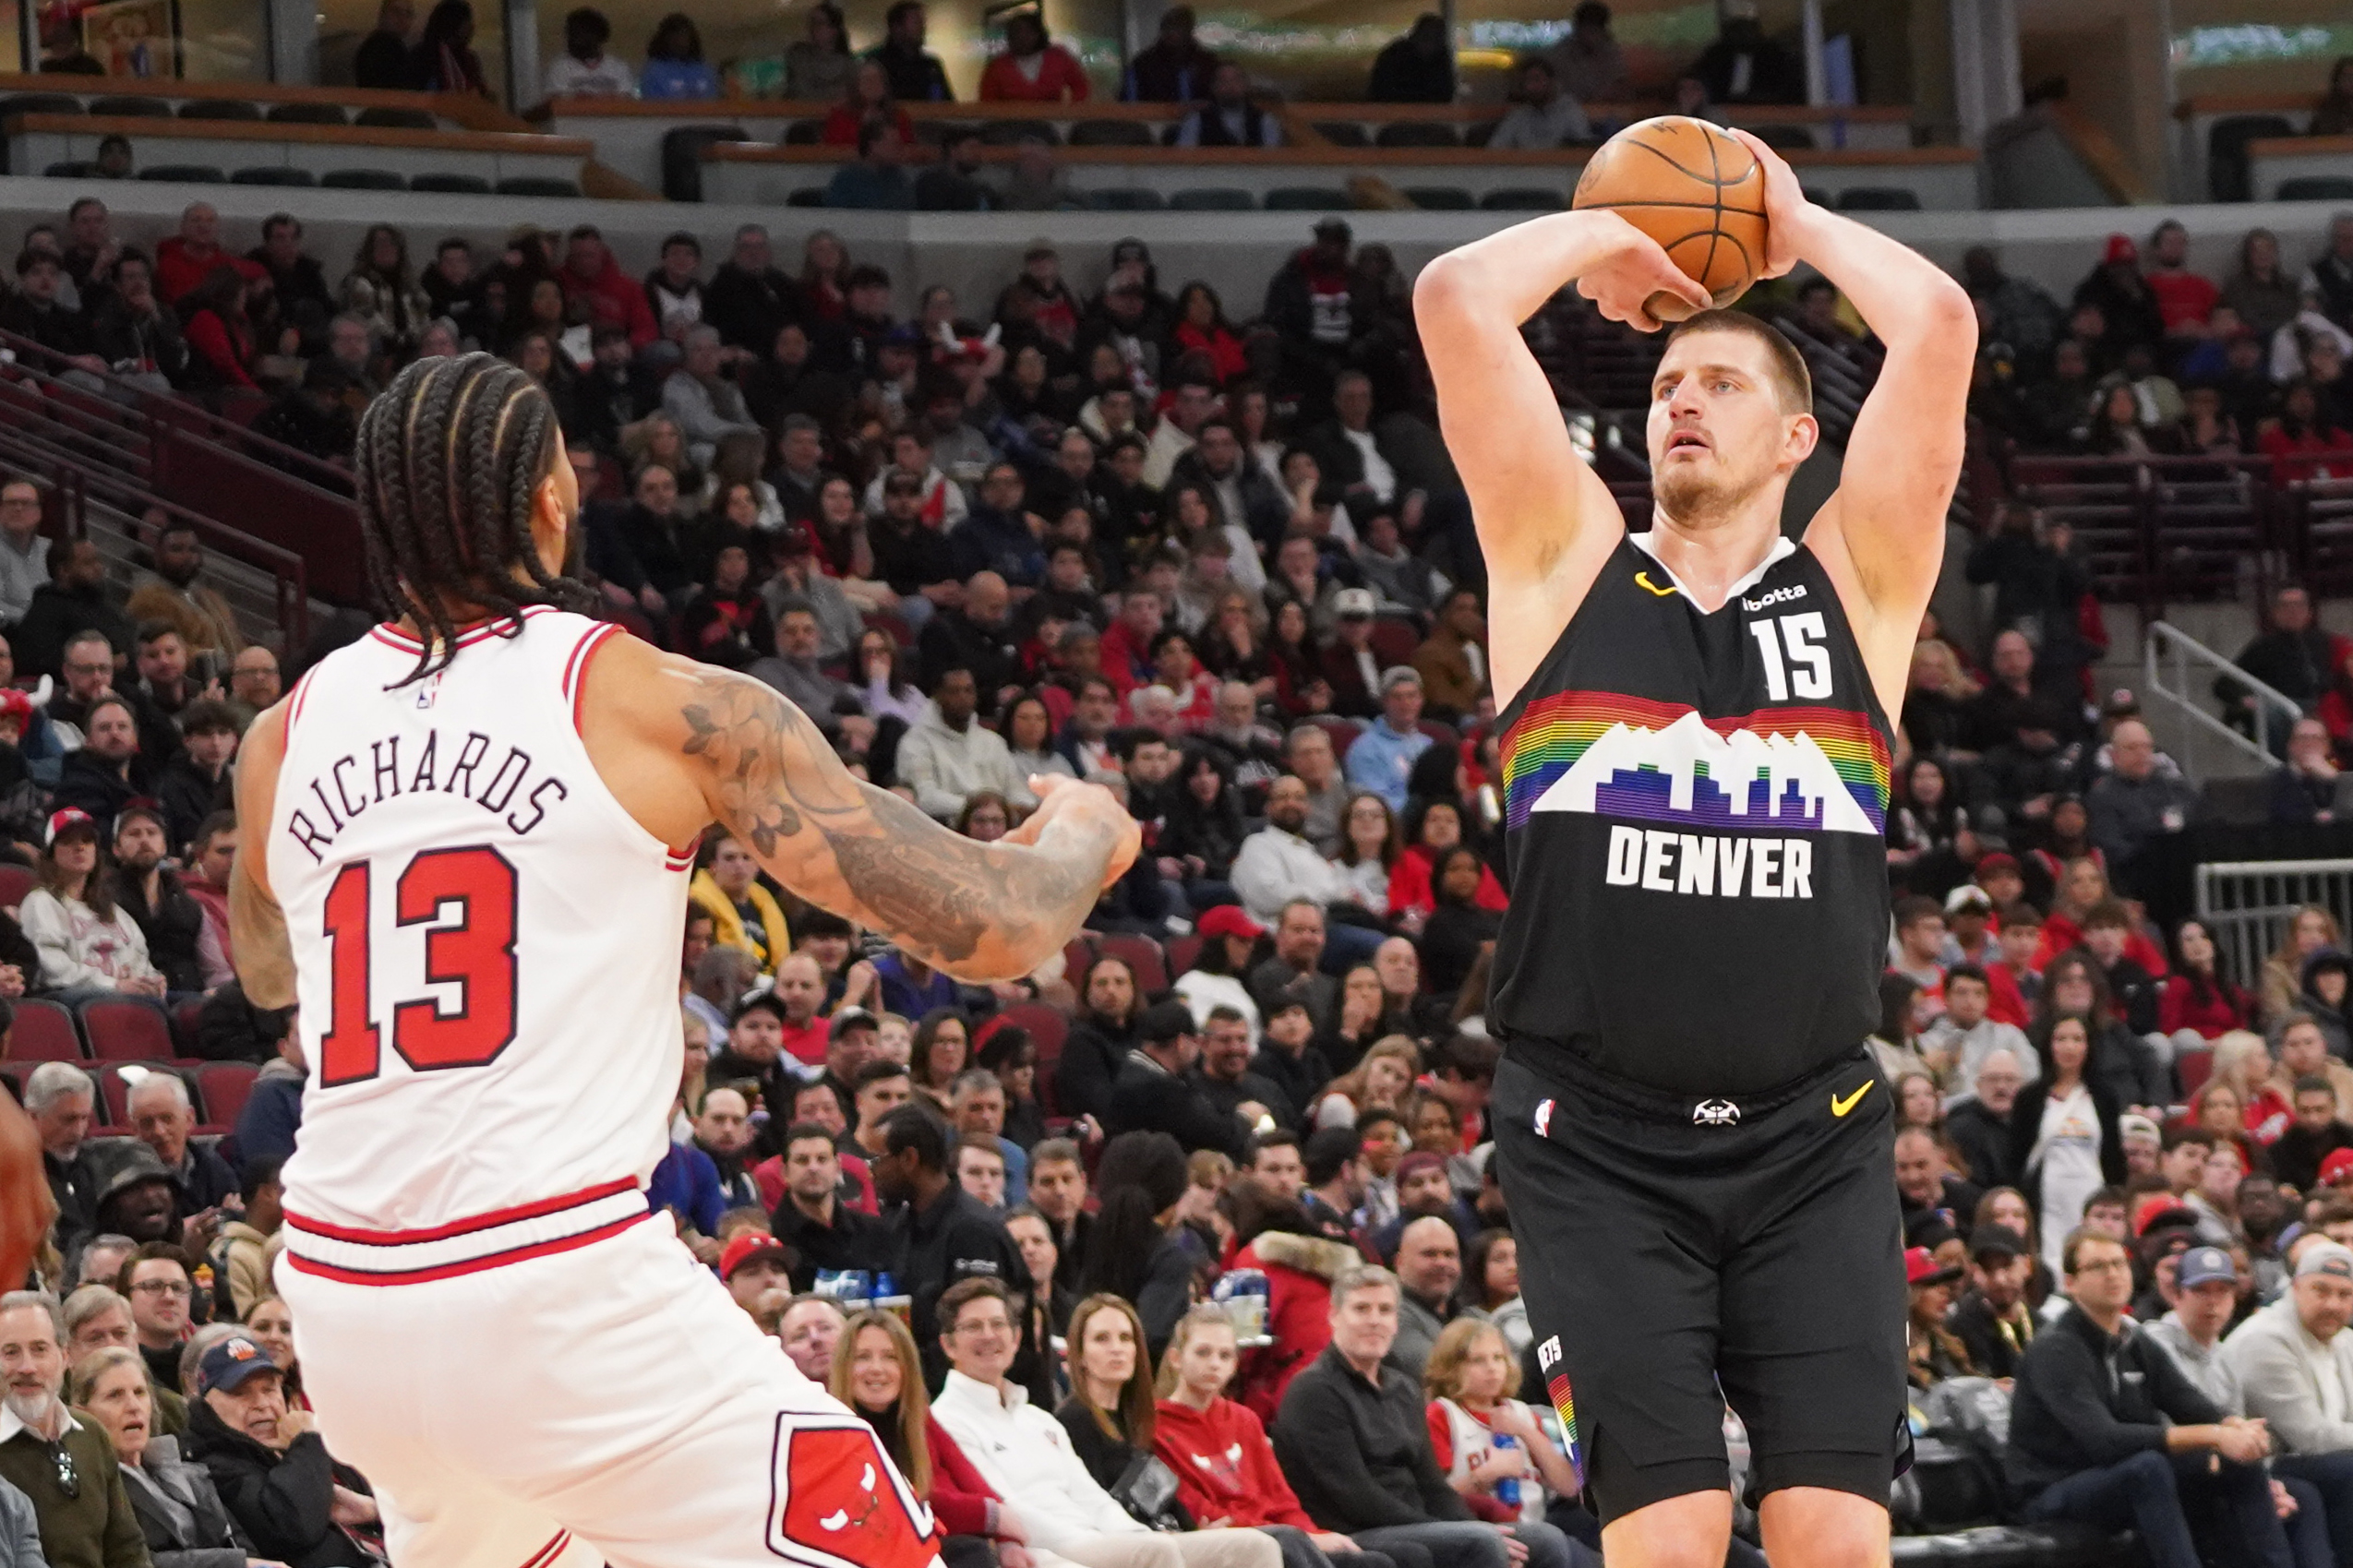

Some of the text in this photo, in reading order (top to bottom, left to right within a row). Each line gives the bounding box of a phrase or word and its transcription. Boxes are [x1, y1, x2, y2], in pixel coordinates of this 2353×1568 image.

[1749, 611, 1833, 701] 15
[288, 728, 568, 865] RICHARDS
[1605, 825, 1814, 899] DENVER
[320, 843, 519, 1090] 13
